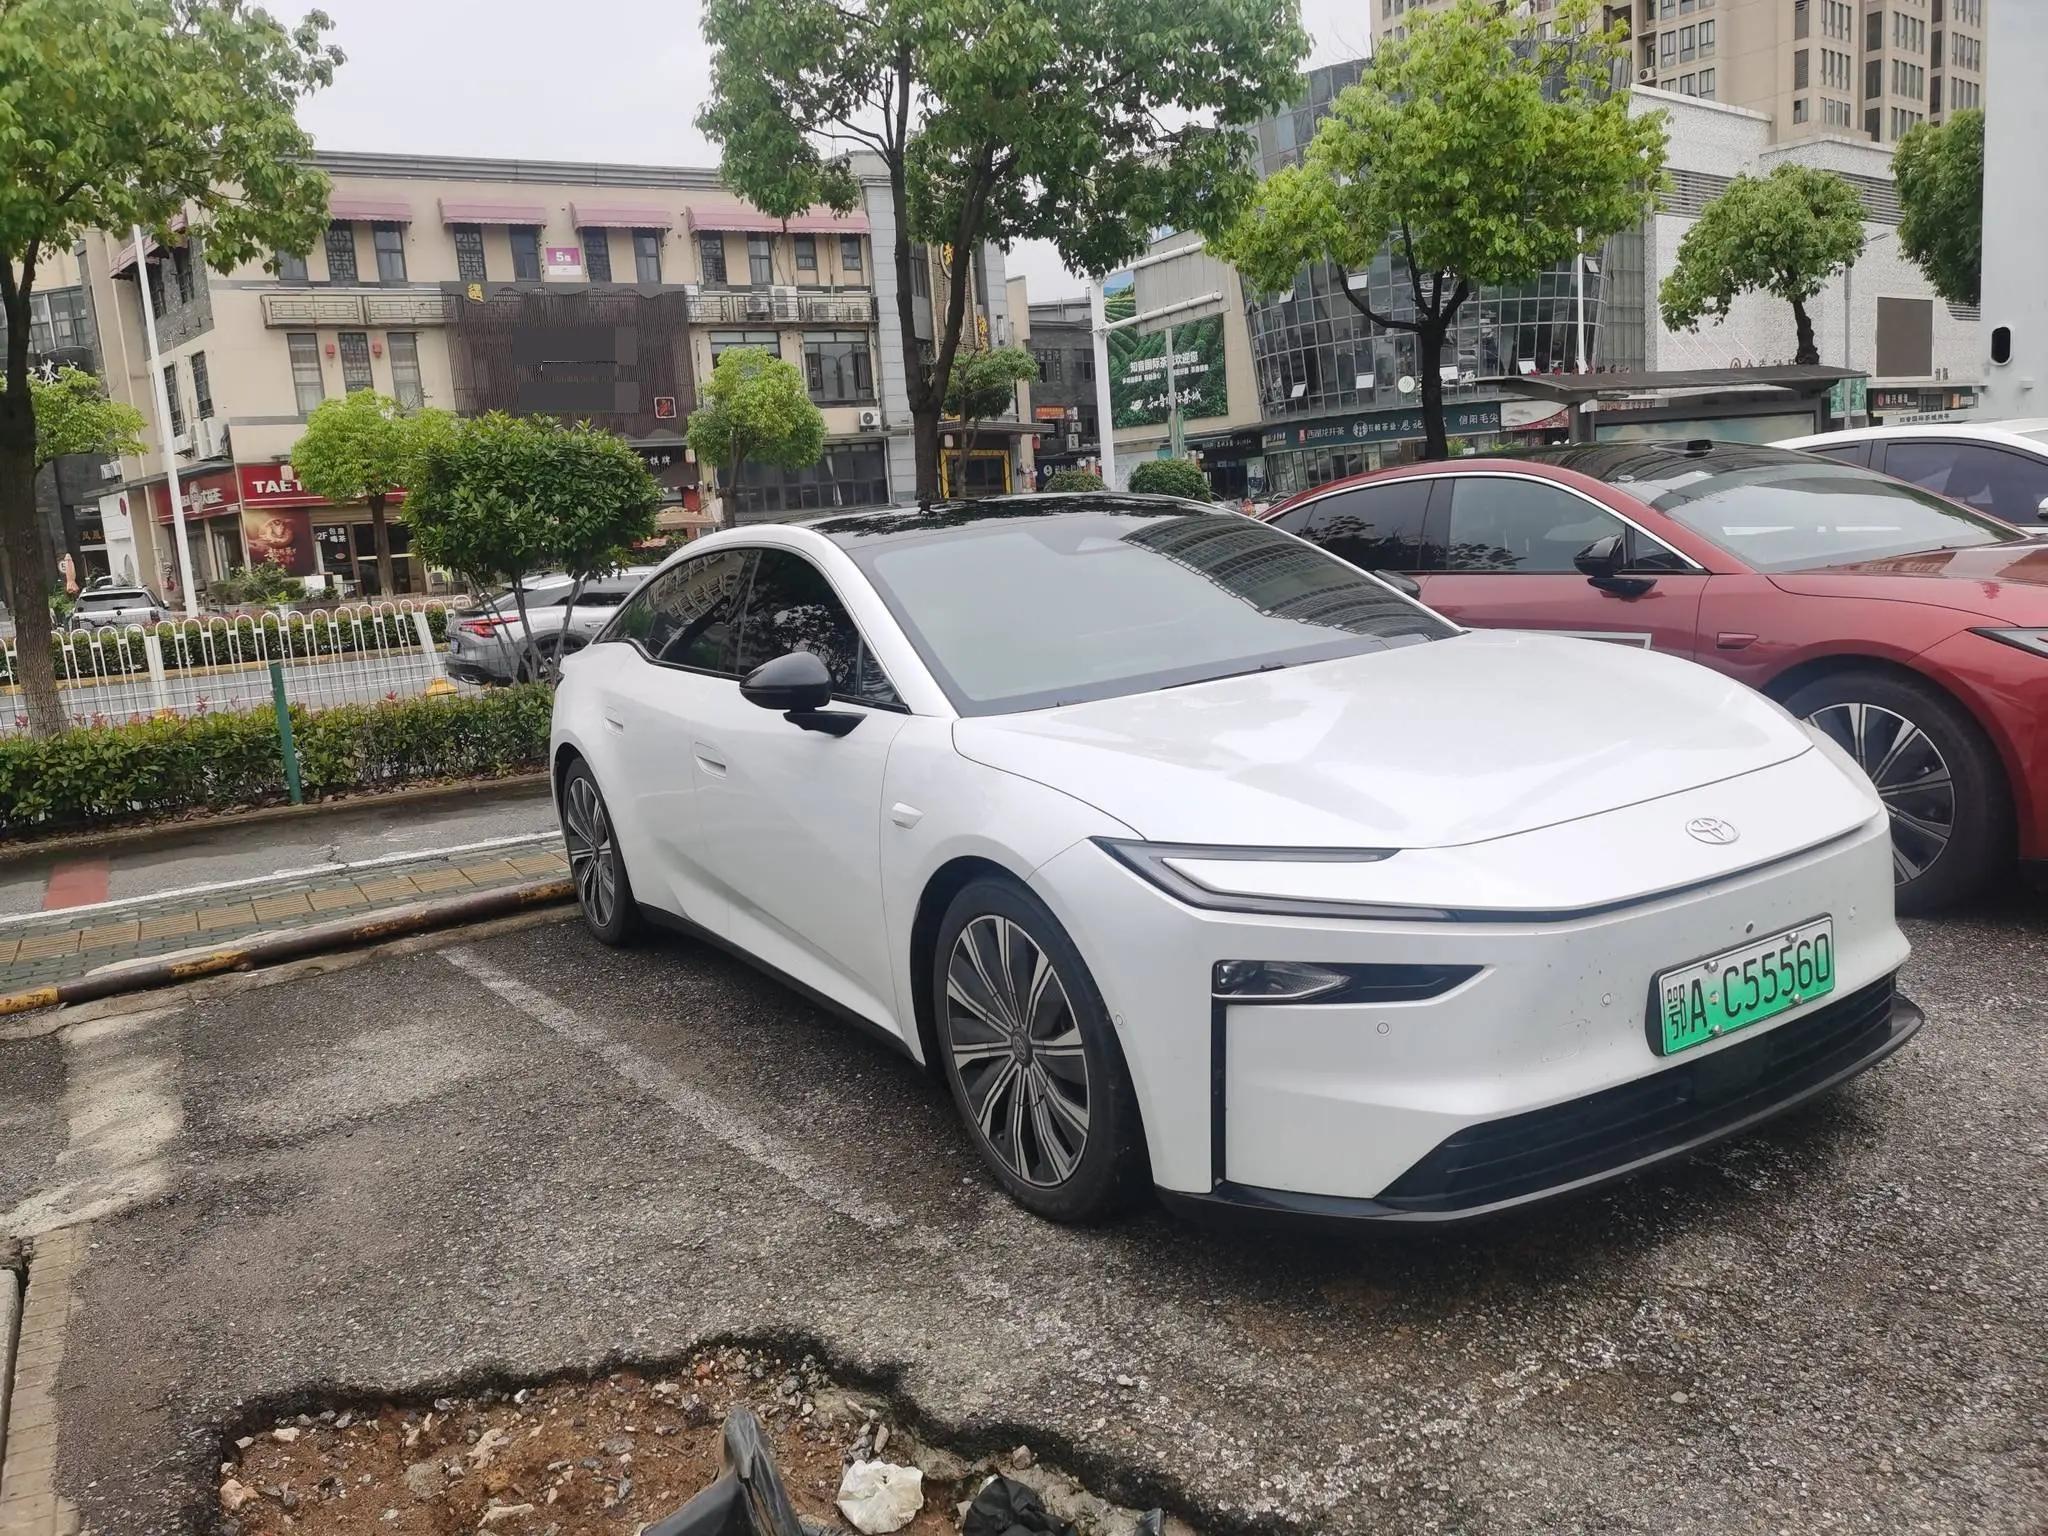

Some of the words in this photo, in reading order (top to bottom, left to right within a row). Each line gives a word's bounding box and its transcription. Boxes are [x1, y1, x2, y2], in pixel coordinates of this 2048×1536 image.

[1130, 351, 1198, 373] 知音国际茶欢迎您
[1459, 412, 1499, 426] 信阳毛尖
